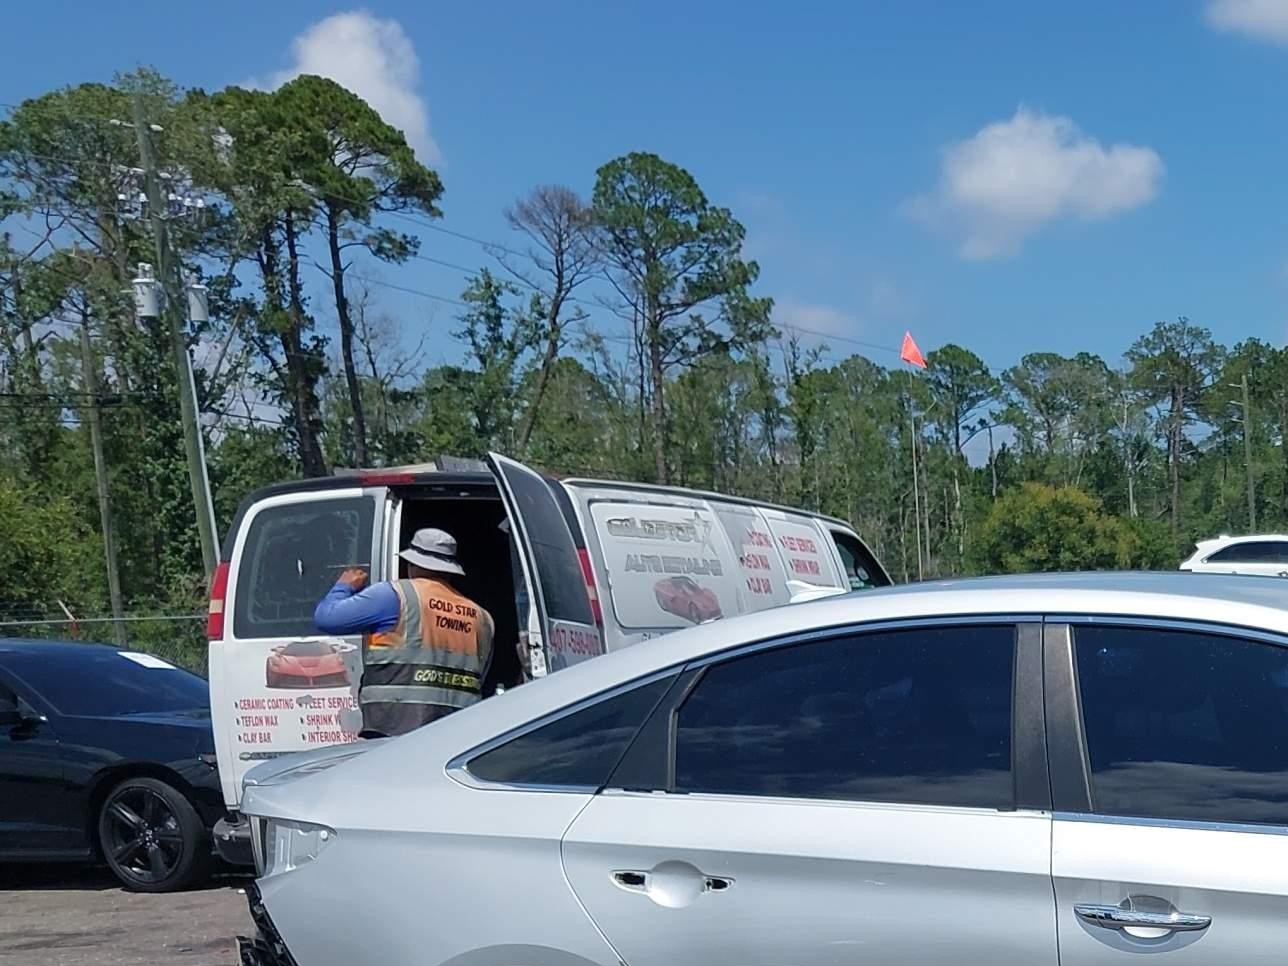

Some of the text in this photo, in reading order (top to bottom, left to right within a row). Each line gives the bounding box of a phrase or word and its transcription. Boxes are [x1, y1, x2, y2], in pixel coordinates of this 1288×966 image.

[429, 598, 478, 619] GOLD STAR
[435, 615, 472, 633] TOWING
[240, 698, 294, 710] CERAMIC COATING
[241, 715, 279, 727] TEFLON WAX
[306, 714, 333, 726] SHRINK
[242, 732, 272, 743] CLAY BAR
[307, 731, 341, 743] INTERIOR
